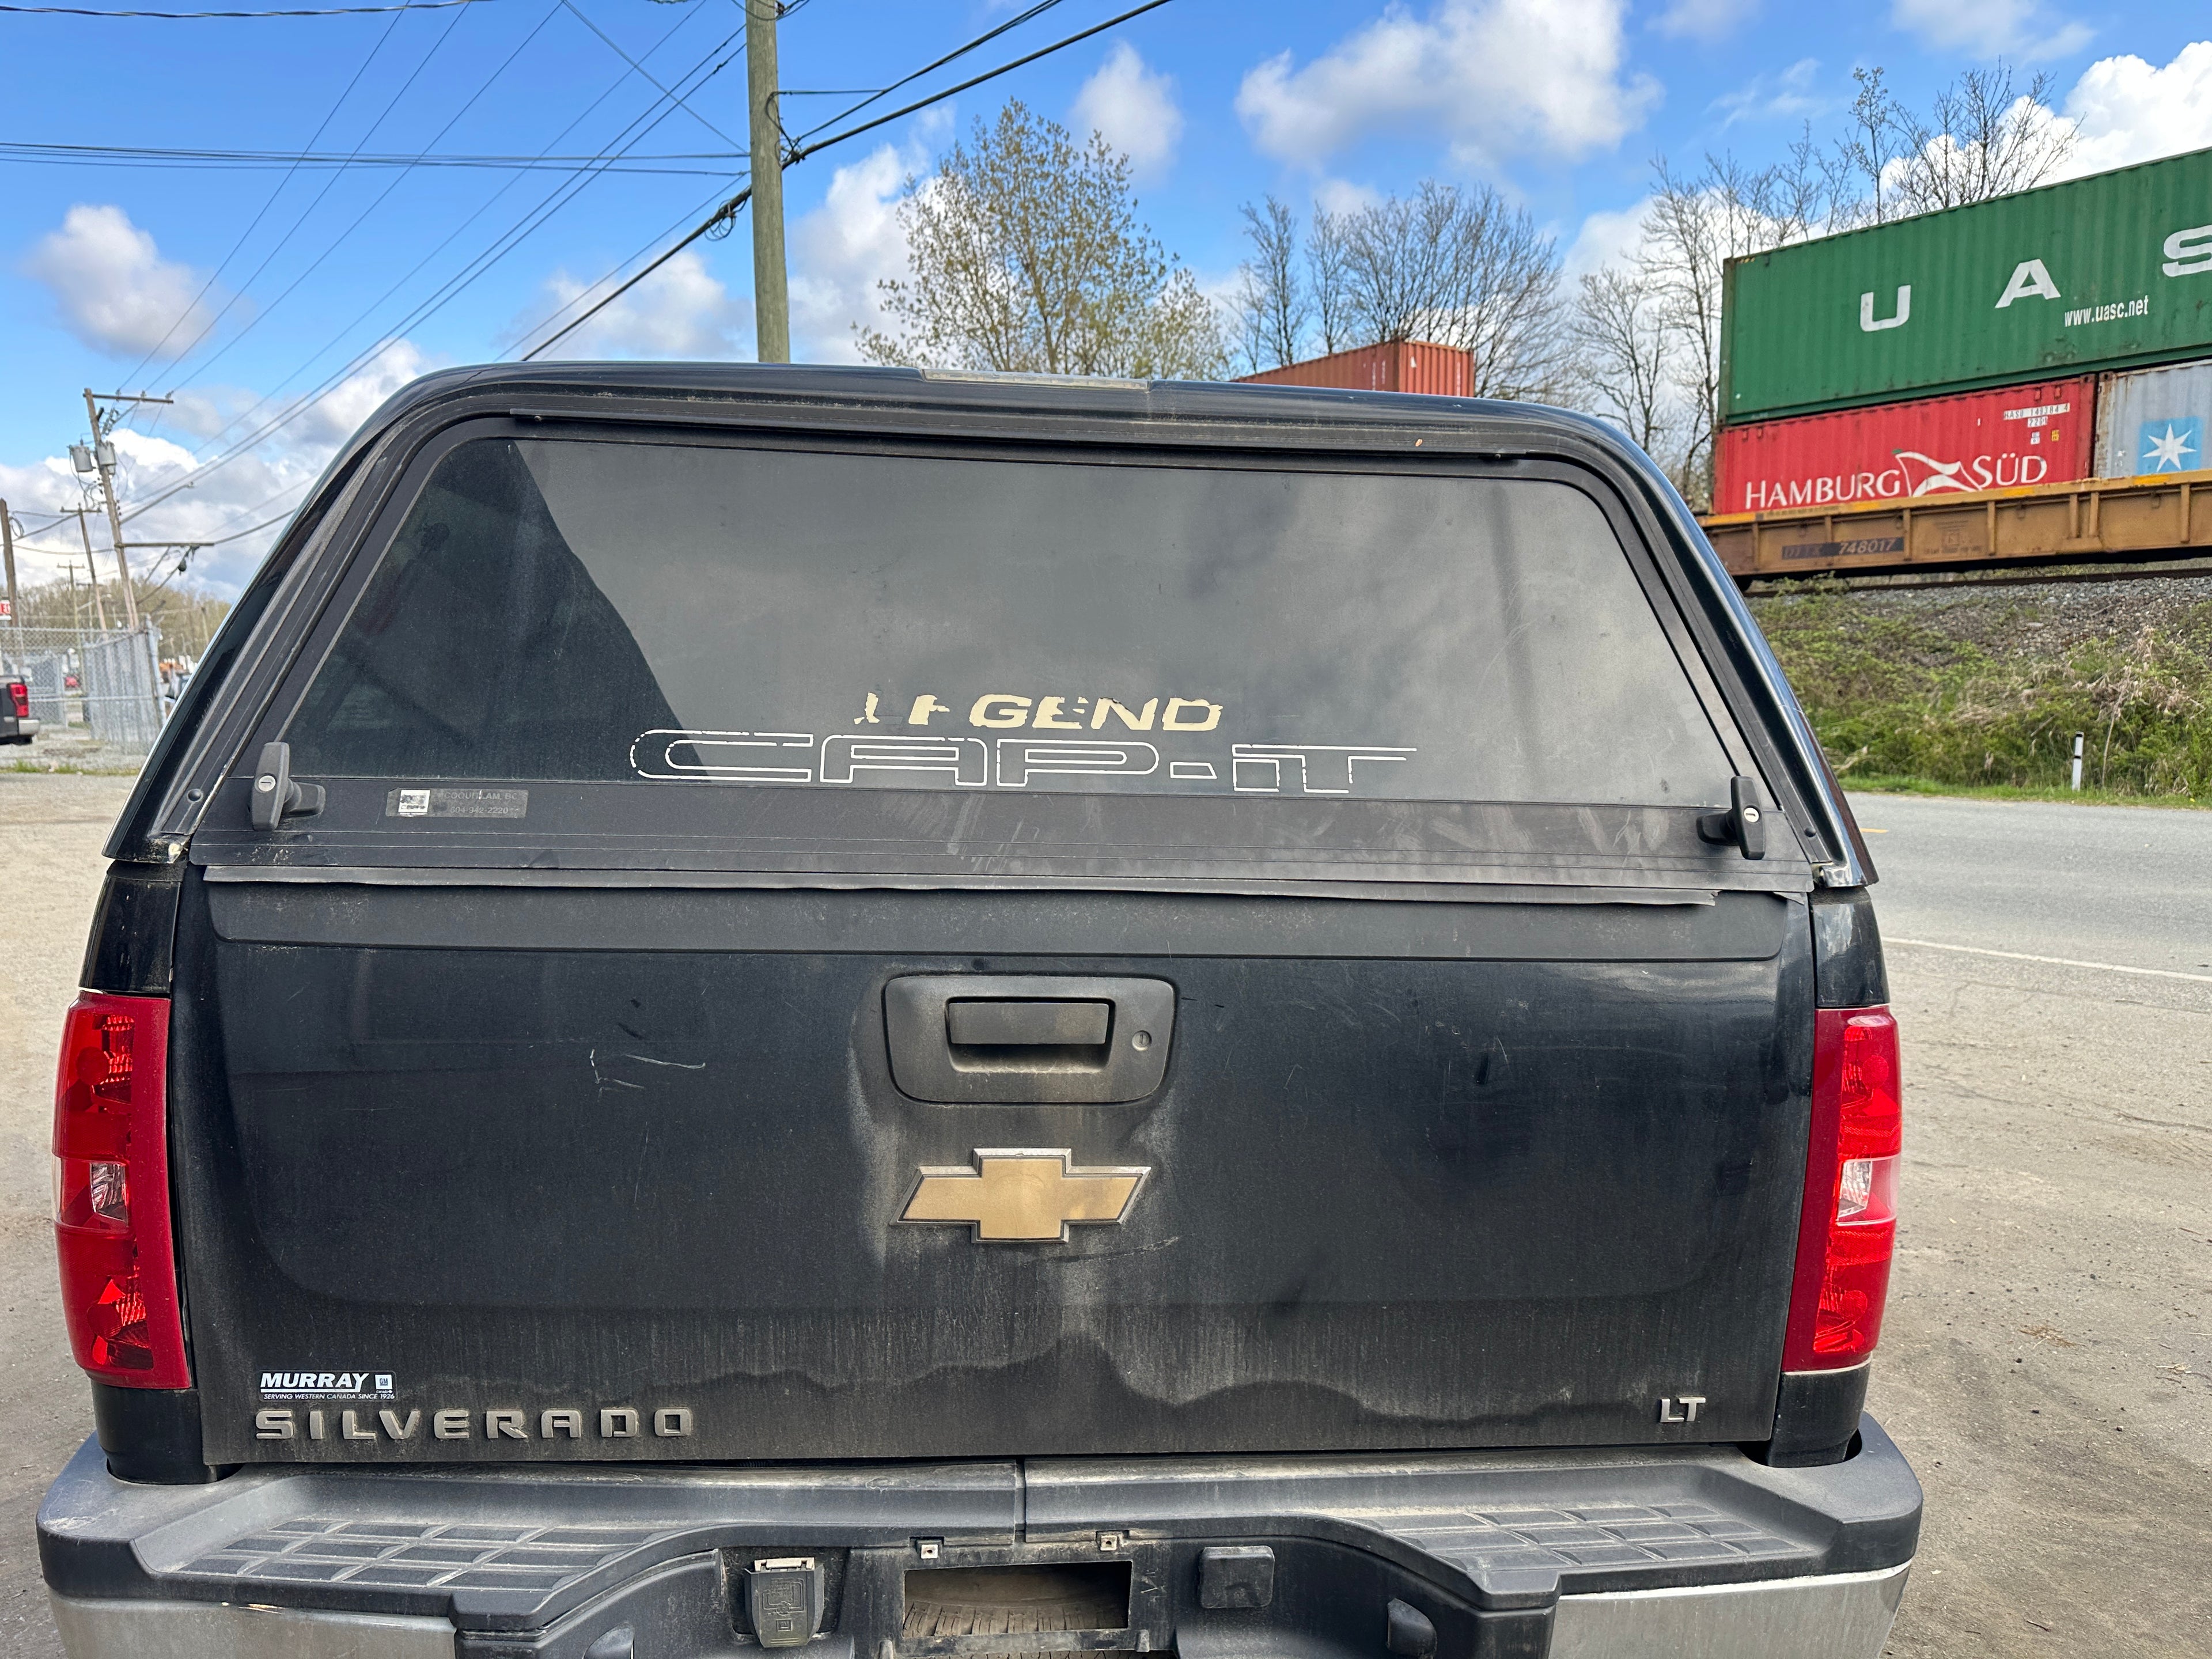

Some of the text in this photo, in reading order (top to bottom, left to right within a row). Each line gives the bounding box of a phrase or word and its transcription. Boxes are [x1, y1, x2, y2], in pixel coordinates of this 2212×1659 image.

[2065, 295, 2149, 328] www.uasc.net
[1745, 453, 2047, 509] HAMBURG SÜD
[1839, 539, 1896, 554] 748017
[260, 1373, 369, 1388] MURRAY
[1660, 1397, 1706, 1422] LT
[256, 1408, 694, 1441] SILVERADO
